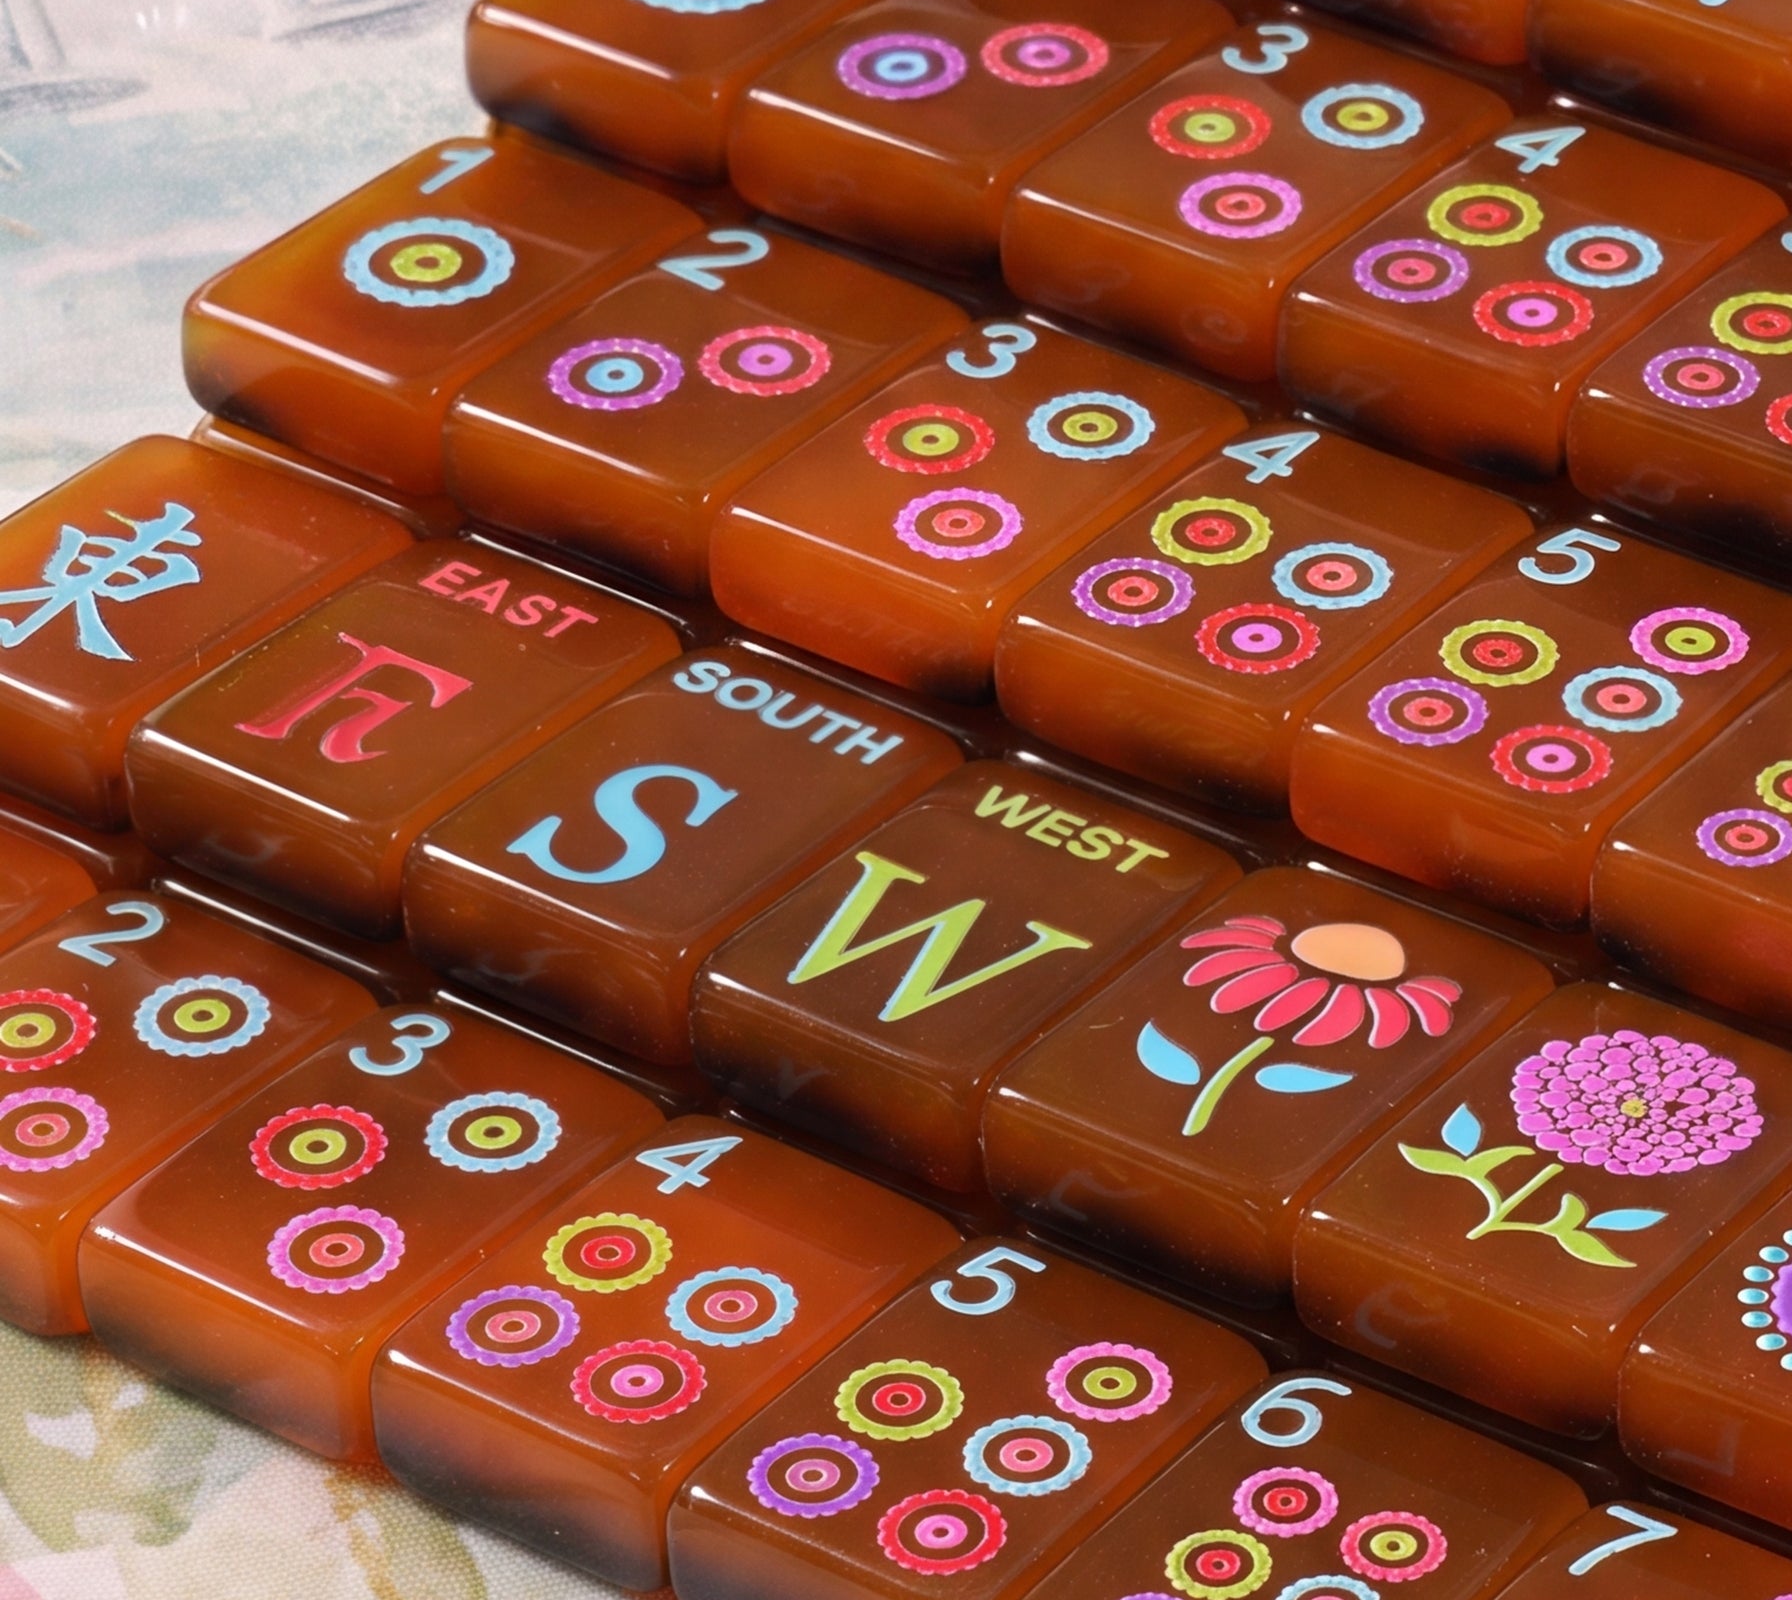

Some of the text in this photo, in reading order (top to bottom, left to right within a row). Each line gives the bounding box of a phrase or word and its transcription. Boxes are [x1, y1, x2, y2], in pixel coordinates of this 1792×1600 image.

[1221, 22, 1309, 76] 3
[420, 147, 493, 194] 1
[1495, 125, 1586, 174] 4
[659, 228, 770, 292] 2
[945, 322, 1038, 379] 3
[1222, 430, 1320, 484] 4
[1518, 527, 1621, 585] 5
[423, 560, 598, 637] EAST
[671, 660, 903, 765] SOUTH
[505, 762, 740, 885] S
[975, 785, 1168, 873] WEST
[59, 900, 166, 967] 2
[786, 850, 1092, 1023] W
[348, 1013, 452, 1076] 3
[636, 1135, 743, 1194] 4
[929, 1245, 1047, 1317] 5
[1240, 1376, 1352, 1448] 6
[1567, 1504, 1677, 1577] 7
